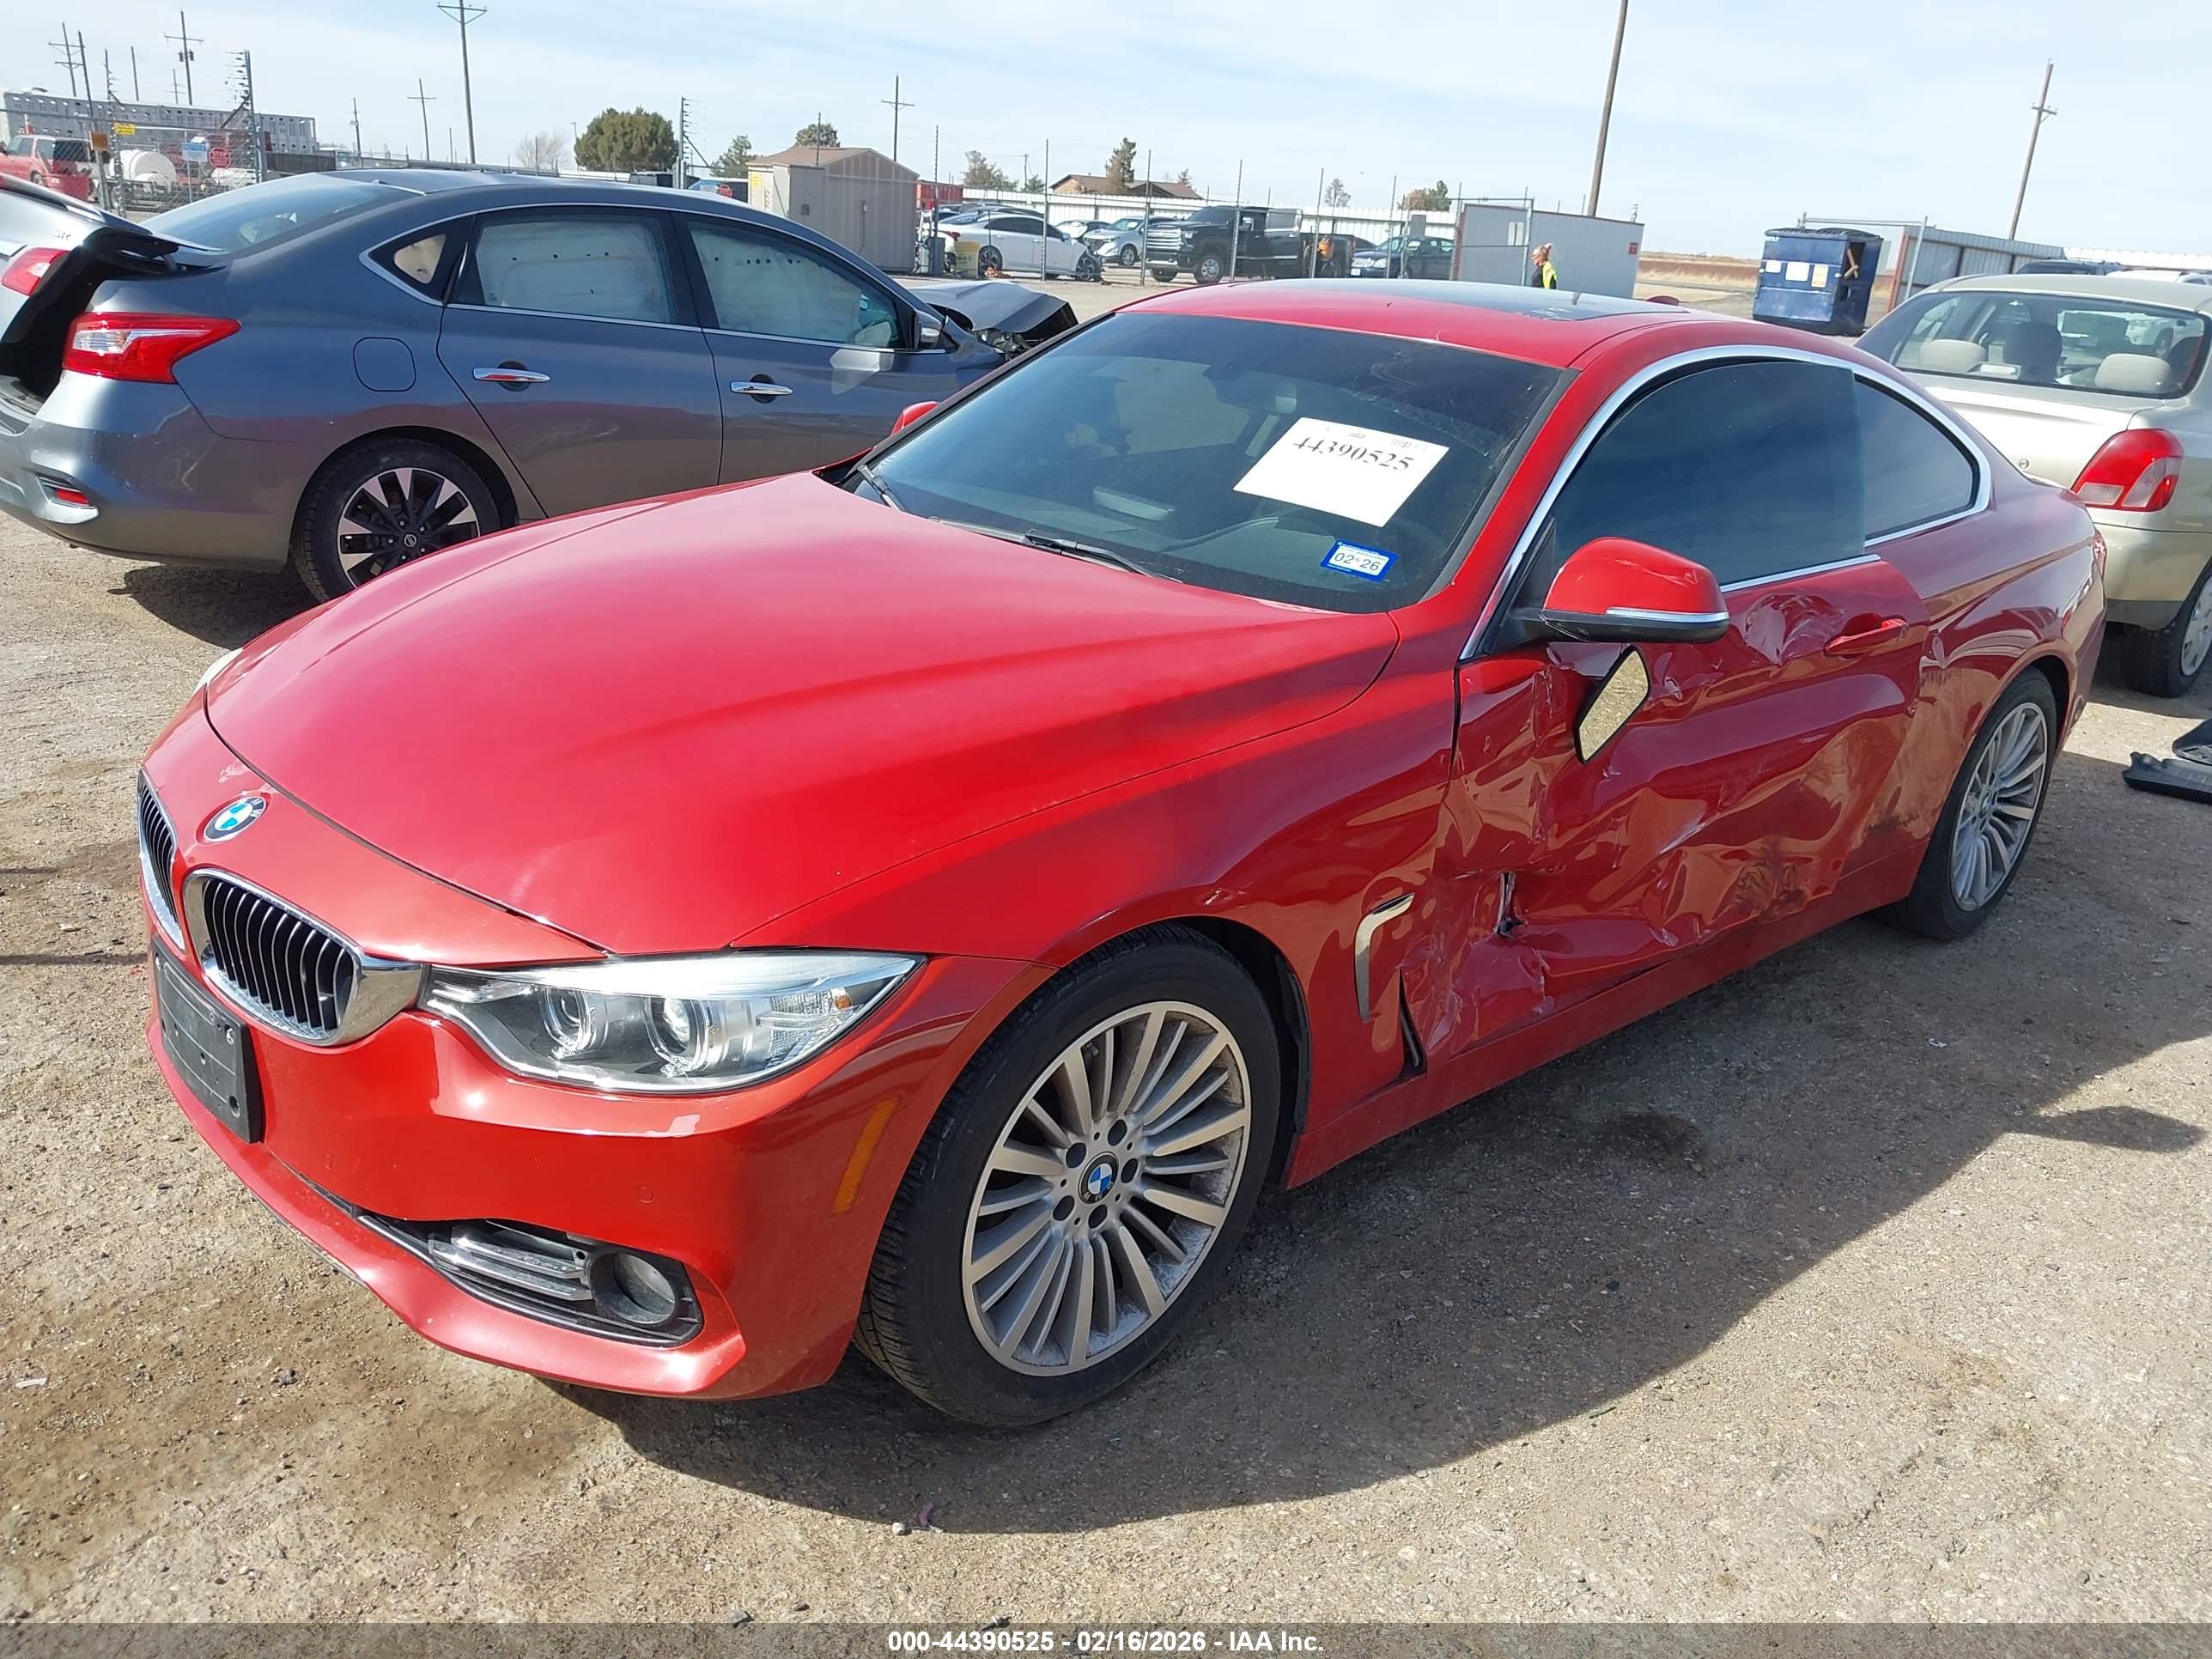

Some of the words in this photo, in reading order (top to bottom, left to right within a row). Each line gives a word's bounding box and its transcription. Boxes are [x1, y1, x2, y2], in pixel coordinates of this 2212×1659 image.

[1293, 436, 1415, 471] 44390525
[1334, 552, 1354, 564] 02
[1360, 558, 1382, 571] 26
